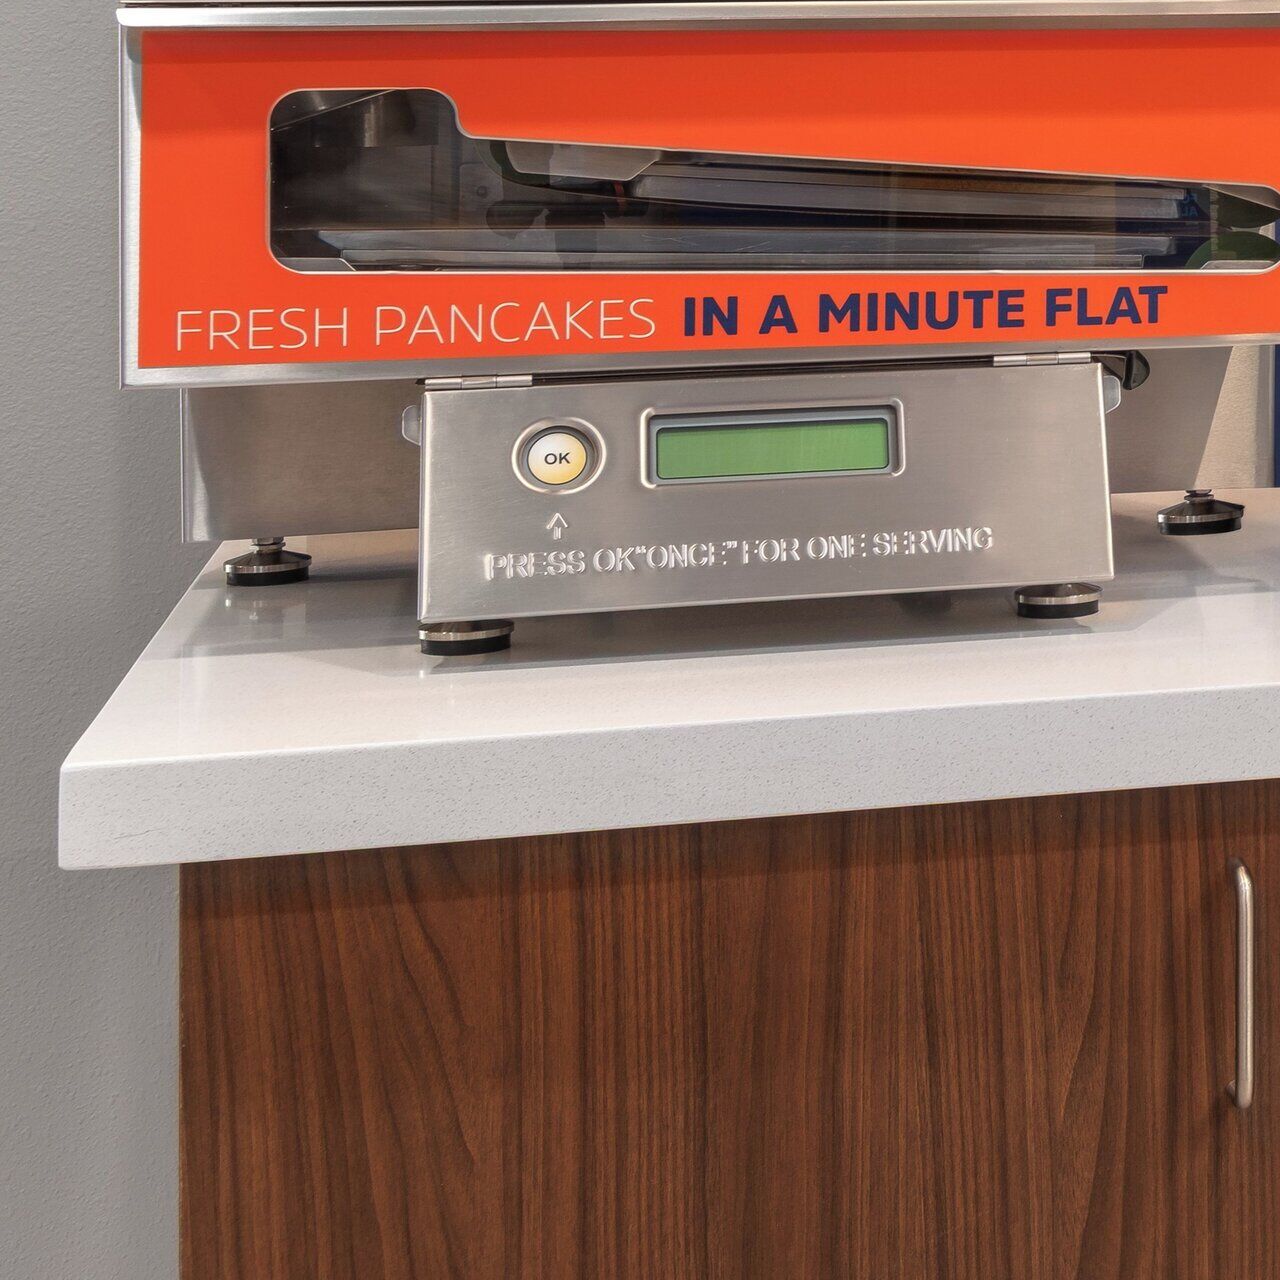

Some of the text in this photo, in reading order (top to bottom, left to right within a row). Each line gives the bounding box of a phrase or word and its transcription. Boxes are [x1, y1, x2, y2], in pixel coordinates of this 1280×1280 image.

[176, 285, 1168, 351] FRESH PANCAKES IN A MINUTE FLAT
[543, 452, 571, 465] OK
[484, 550, 586, 580] PRESS
[593, 547, 636, 572] OK
[742, 538, 801, 565] FOR
[806, 533, 867, 560] ONE
[872, 526, 993, 555] SERVING
